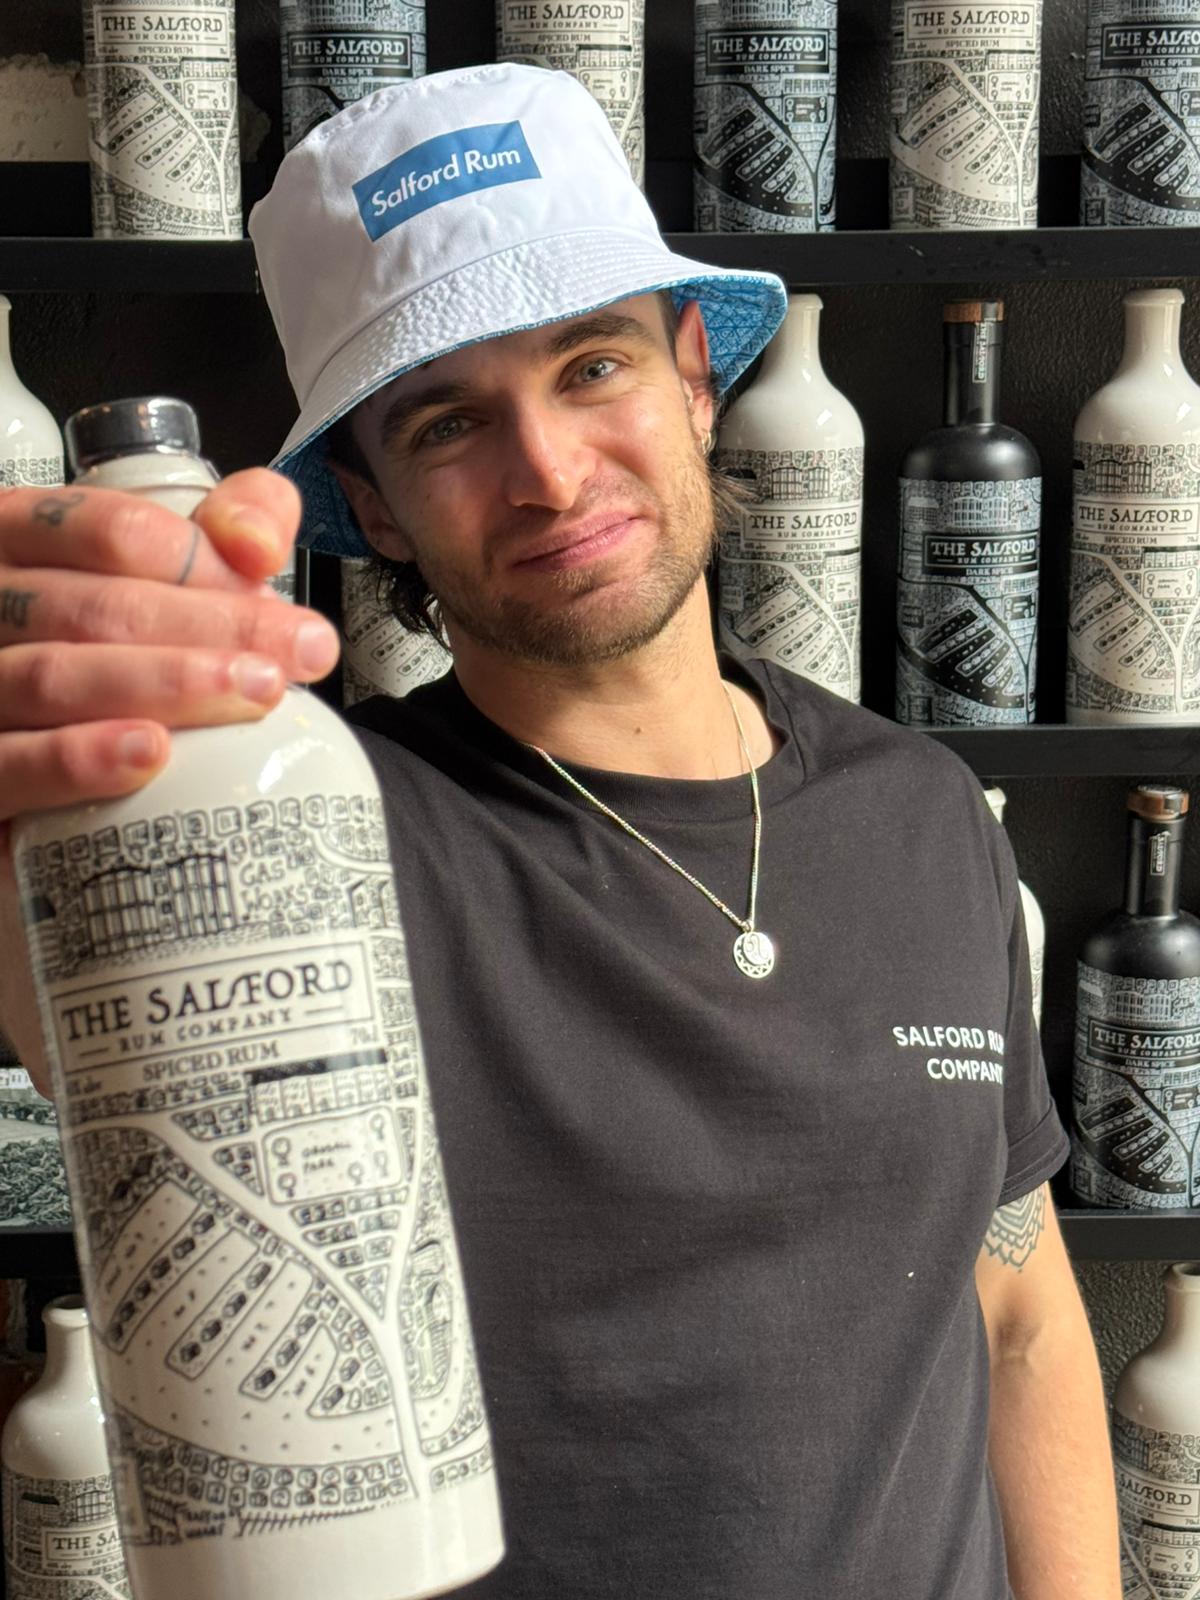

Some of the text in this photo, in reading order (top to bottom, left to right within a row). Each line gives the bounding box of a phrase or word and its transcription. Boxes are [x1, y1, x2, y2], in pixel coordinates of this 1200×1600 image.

[508, 5, 537, 20] THE
[912, 11, 945, 27] THE
[102, 16, 136, 31] THE
[712, 38, 744, 53] THE
[1108, 32, 1142, 47] THE
[292, 41, 322, 55] THE
[371, 149, 521, 217] Salford Rum
[1079, 506, 1105, 521] THE
[750, 515, 785, 529] THE
[931, 542, 966, 556] THE
[239, 860, 286, 886] GAS
[61, 960, 352, 1041] THE SALFORD
[119, 1007, 293, 1053] RUM COMPANY
[1094, 1027, 1126, 1046] THE
[893, 1026, 1004, 1055] SALFORD RU
[143, 1040, 280, 1081] SPICED RUM
[53, 1536, 91, 1550] THE
